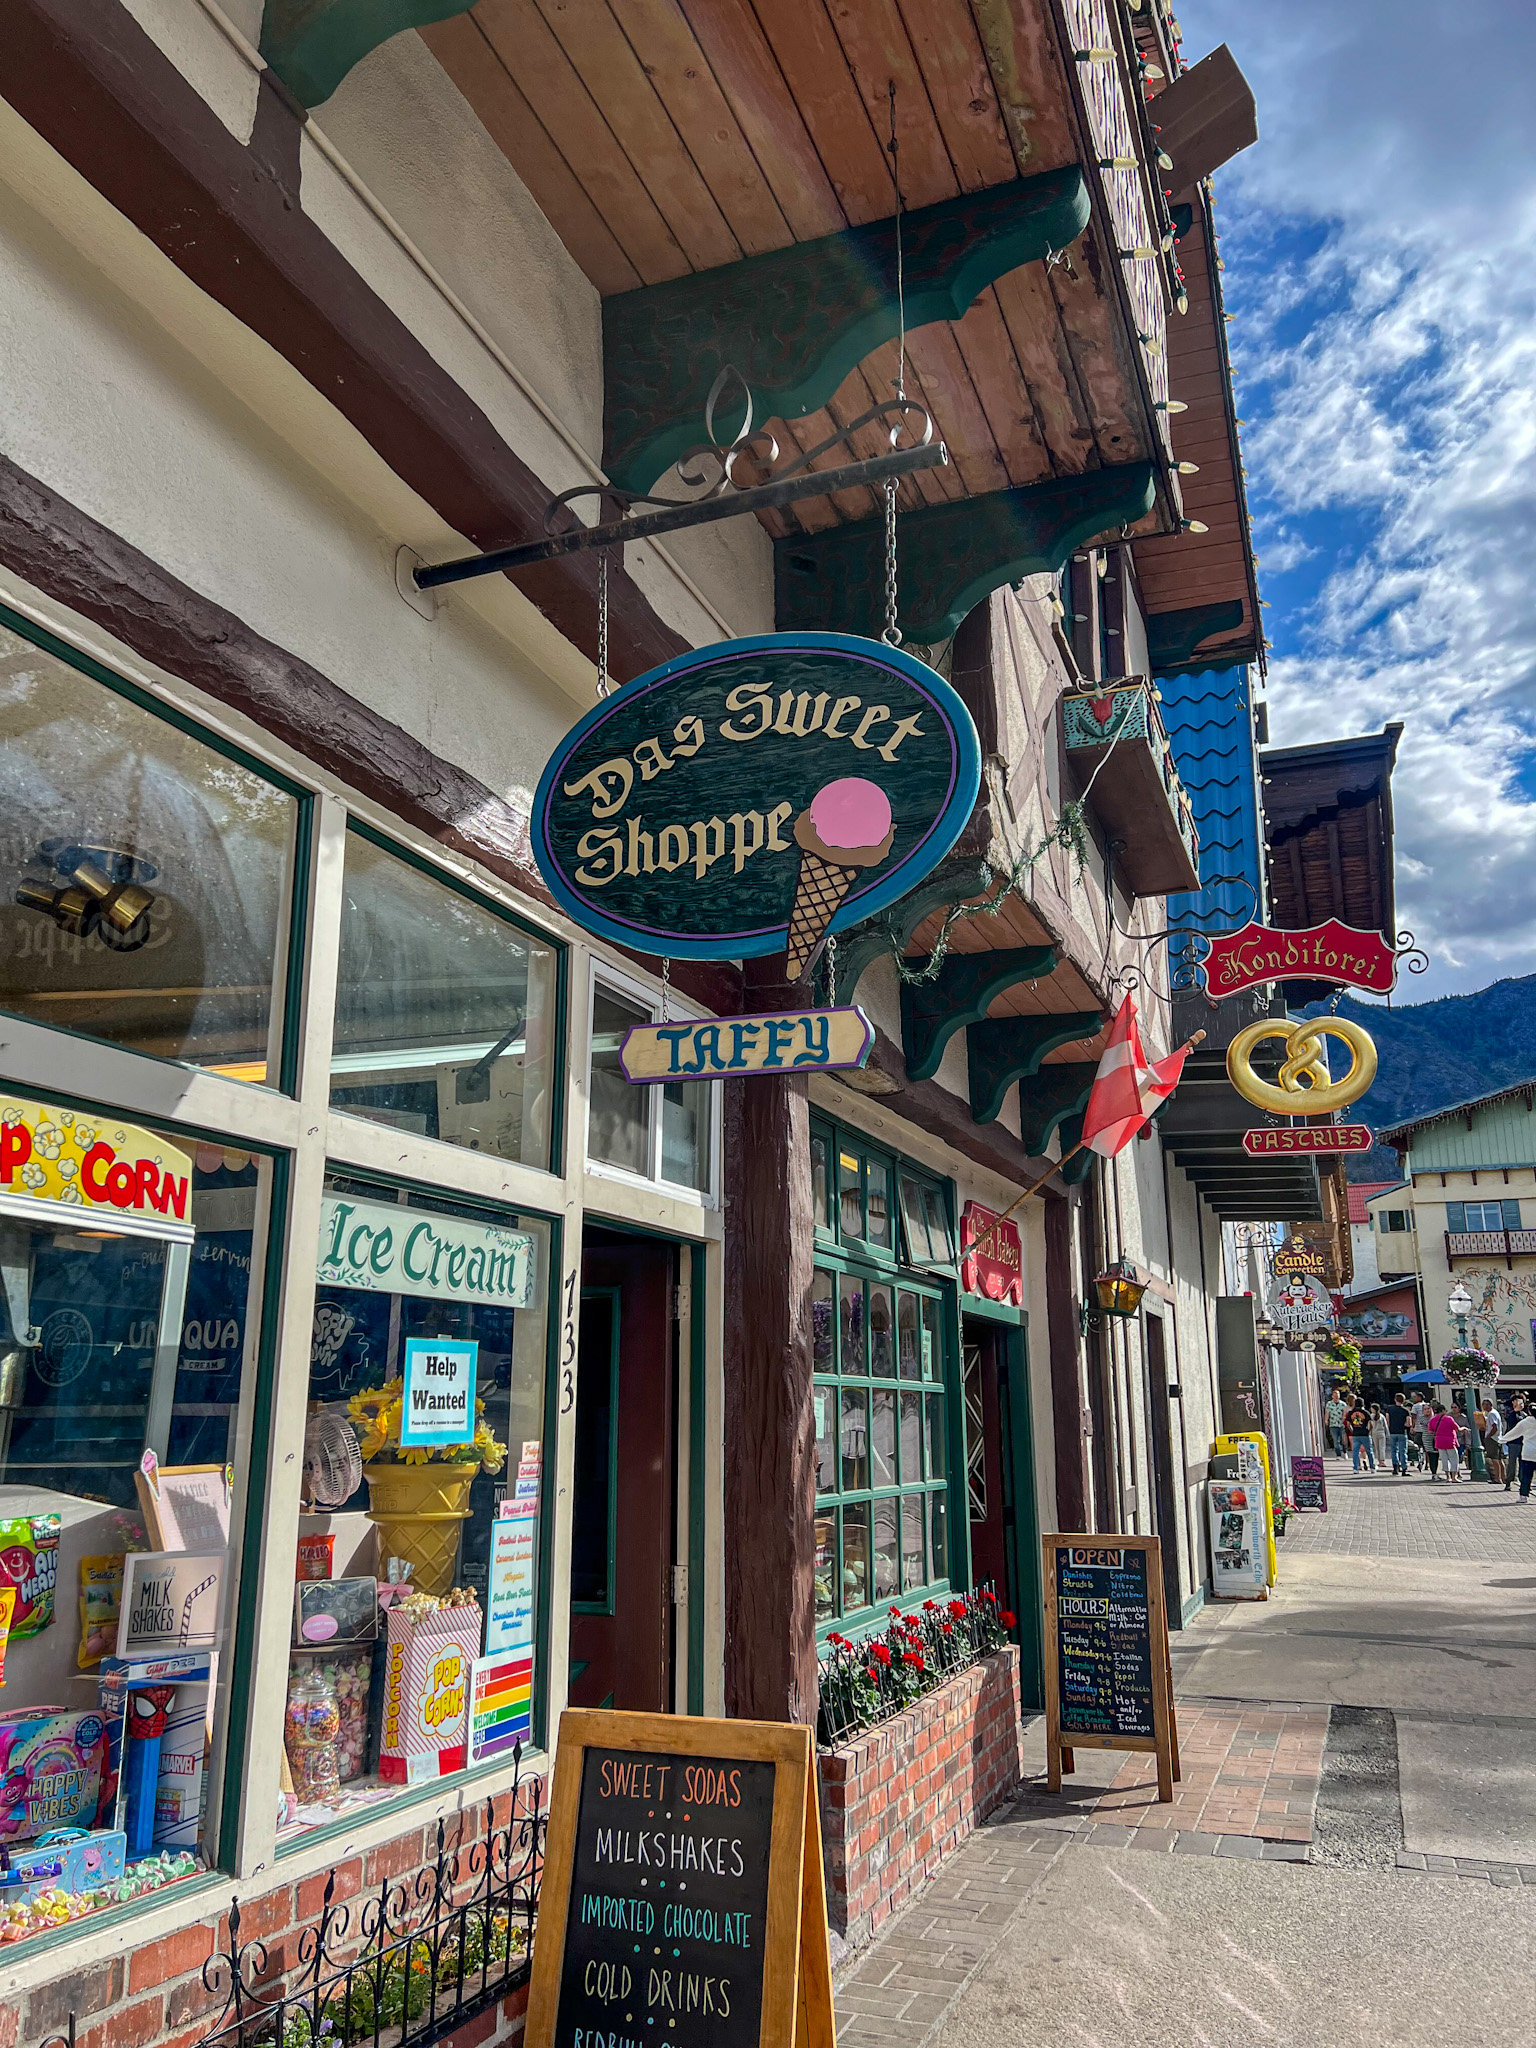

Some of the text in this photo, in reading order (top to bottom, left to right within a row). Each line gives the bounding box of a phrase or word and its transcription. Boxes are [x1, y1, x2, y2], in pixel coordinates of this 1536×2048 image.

[564, 682, 926, 818] Das Sweet
[575, 801, 793, 886] Shoppe
[1218, 935, 1380, 985] Konditorei
[657, 1016, 830, 1074] TAFFY
[1251, 1128, 1364, 1149] PASTRIES
[81, 1142, 188, 1220] CORN
[323, 1203, 518, 1295] Ice Cream
[997, 1226, 1019, 1272] Bakery
[1275, 1252, 1325, 1267] Candle
[1269, 1301, 1331, 1318] Nutcracker
[1282, 1311, 1325, 1330] Haus
[1307, 1332, 1327, 1342] Shop
[425, 1355, 457, 1381] Help
[412, 1390, 466, 1411] Wanted
[1249, 1486, 1257, 1502] The
[1075, 1549, 1119, 1567] OPEN
[1063, 1569, 1093, 1580] Danishes
[140, 1577, 174, 1608] MILK
[1110, 1581, 1134, 1590] Nitro
[1063, 1599, 1106, 1615] HOURS
[1063, 1619, 1093, 1634] Monday
[1119, 1621, 1145, 1629] Almond
[1061, 1631, 1089, 1648] Tuesday
[1109, 1631, 1138, 1641] Redbull
[1063, 1644, 1099, 1660] Wednesday
[1062, 1655, 1095, 1674] Thursday
[1115, 1661, 1140, 1671] Sodas
[434, 1656, 460, 1692] POP
[1064, 1669, 1090, 1685] Friday
[1114, 1671, 1136, 1682] Pepsi
[386, 1642, 404, 1749] POPCORN
[475, 1684, 485, 1701] ONE
[1064, 1681, 1098, 1697] Saturday
[1115, 1681, 1150, 1693] Products
[424, 1684, 463, 1727] CORN!
[1066, 1692, 1096, 1706] Sunday
[1115, 1694, 1136, 1705] Hot
[1116, 1713, 1137, 1723] Iced
[161, 1754, 194, 1774] MARVEL
[30, 1769, 88, 1801] HAPPY
[600, 1759, 741, 1807] SWEET SODAS
[595, 1827, 744, 1877] MILKSHAKES
[581, 1893, 751, 1948] IMPORTED CHOCOLATE
[585, 1959, 731, 2018] COLD DRINKS
